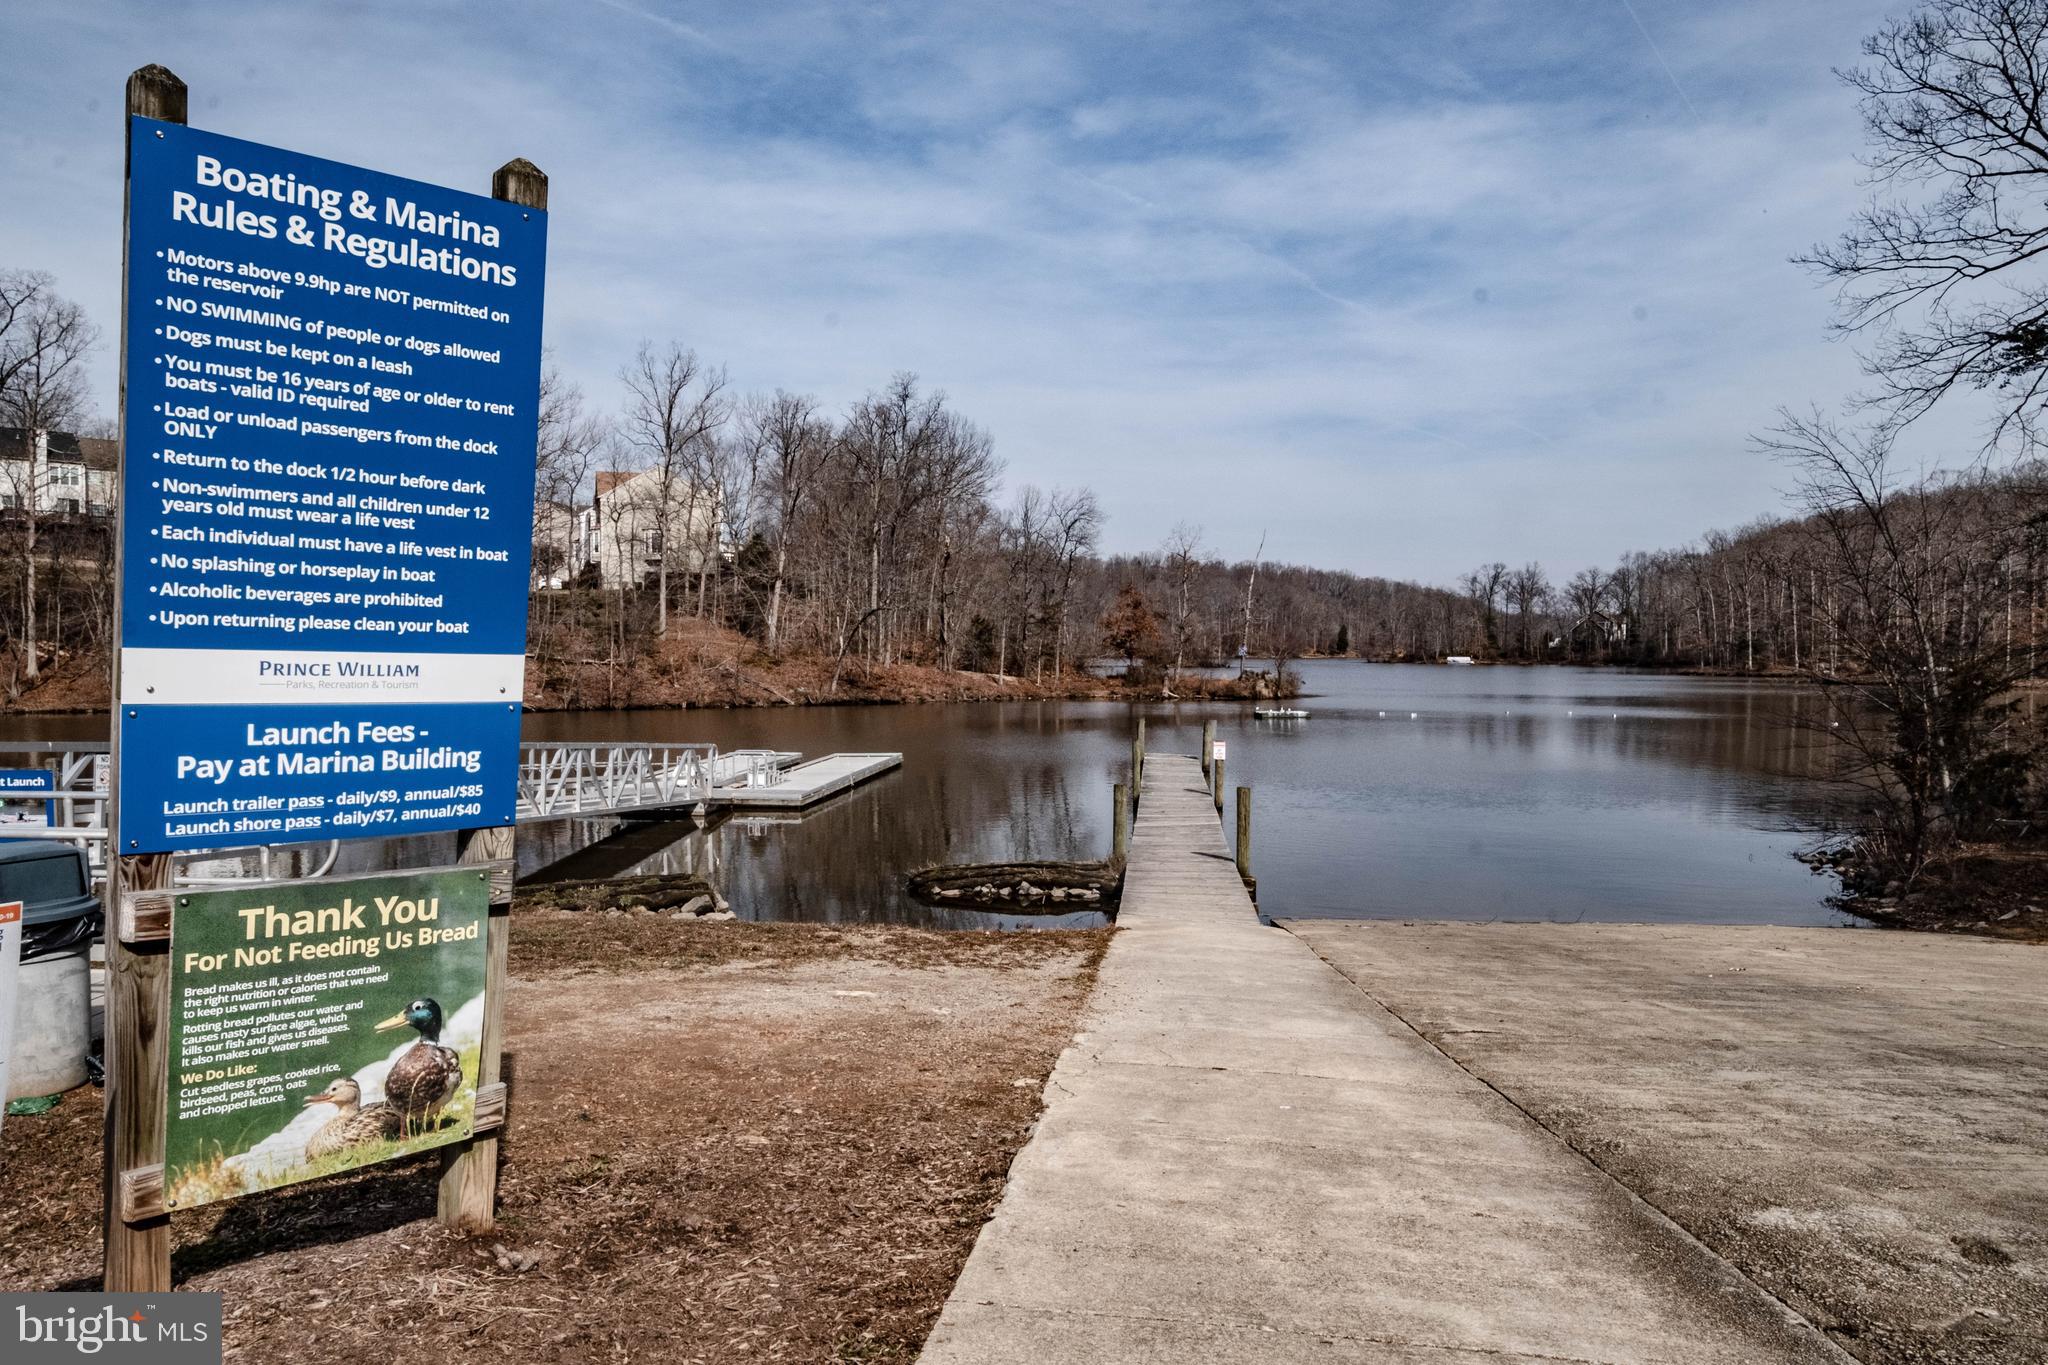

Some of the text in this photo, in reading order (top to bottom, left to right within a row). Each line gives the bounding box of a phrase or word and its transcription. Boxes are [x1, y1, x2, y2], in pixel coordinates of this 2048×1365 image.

[197, 154, 500, 248] Boating & Marina
[173, 190, 516, 286] Rules & Regulations
[166, 267, 284, 300] the reservoir
[167, 248, 509, 323] Motors above 9.9hp are NOT permitted on
[166, 296, 500, 363] NO SWIMMING of people or dogs allowed
[166, 325, 412, 376] Dogs must be kept on a leash
[164, 449, 485, 494] Return to the dock 1/2 hour before dark
[162, 498, 415, 530] years old must wear a life vest
[163, 478, 489, 520] Non-swimmers and all children under 12
[162, 525, 508, 562] Each individual must have a life vest in boat
[161, 553, 436, 582] No splashing or horseplay in boat
[159, 582, 443, 608] Alcoholic beverages are prohibited
[160, 610, 469, 635] Upon returning please clean your boat
[259, 660, 419, 677] PRINCE WILLIAM
[286, 679, 418, 690] Parks, Recreation & Tourism
[247, 721, 350, 746] Launch
[358, 721, 415, 743] Fees
[177, 746, 481, 784] Pay at Marina Building
[7, 777, 45, 787] Launch
[163, 798, 228, 815] Launch
[232, 795, 285, 812] trailer
[287, 796, 324, 811] pass
[336, 789, 400, 807] daily/$9,
[404, 784, 483, 801] annual/$85
[165, 818, 230, 837] Launch
[233, 817, 282, 833] shore
[284, 816, 321, 831] pass
[333, 809, 397, 826] daily/$7,
[401, 803, 481, 820] annual/$40
[238, 895, 439, 940] Thank You
[184, 921, 479, 973] For Not Feeding Us Bread
[184, 964, 380, 997] Bread makes us ill, as it does not contain
[183, 994, 317, 1019] to keep us warm in winter.
[183, 1000, 363, 1034] Rotting bread pollutes our water and
[182, 1012, 347, 1045] causes nasty surface algae, which
[180, 1064, 257, 1084] We Do Like:
[180, 1064, 341, 1098] Cut seedless grapes, cooked rice,
[180, 1079, 307, 1108] birdseed, peas, corn, oats
